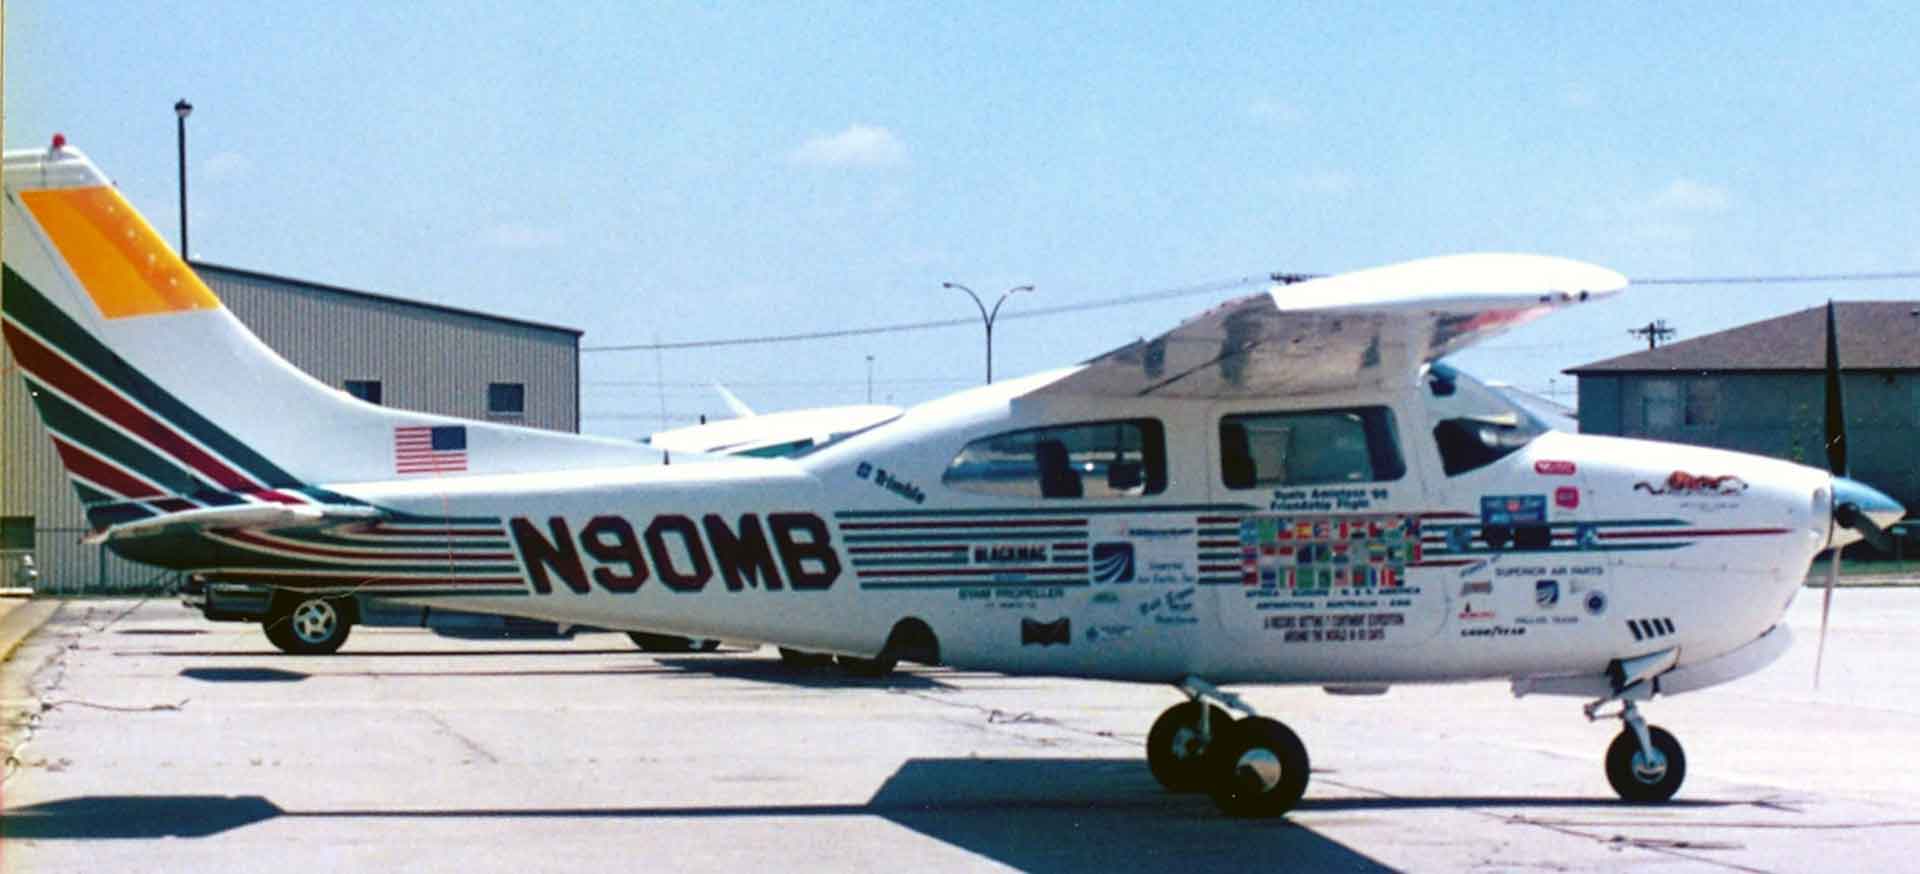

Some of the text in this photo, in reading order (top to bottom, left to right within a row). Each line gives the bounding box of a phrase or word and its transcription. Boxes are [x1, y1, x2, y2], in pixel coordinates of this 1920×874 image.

[1336, 497, 1369, 511] Flight
[509, 512, 842, 594] N90MB
[1496, 566, 1546, 576] SUPERIOR
[1551, 566, 1567, 575] AIR
[1571, 565, 1604, 575] PARTS
[1378, 587, 1420, 595] AMERICA
[1256, 601, 1315, 610] ANTARCTICA
[1327, 600, 1378, 609] AUSTRALIA
